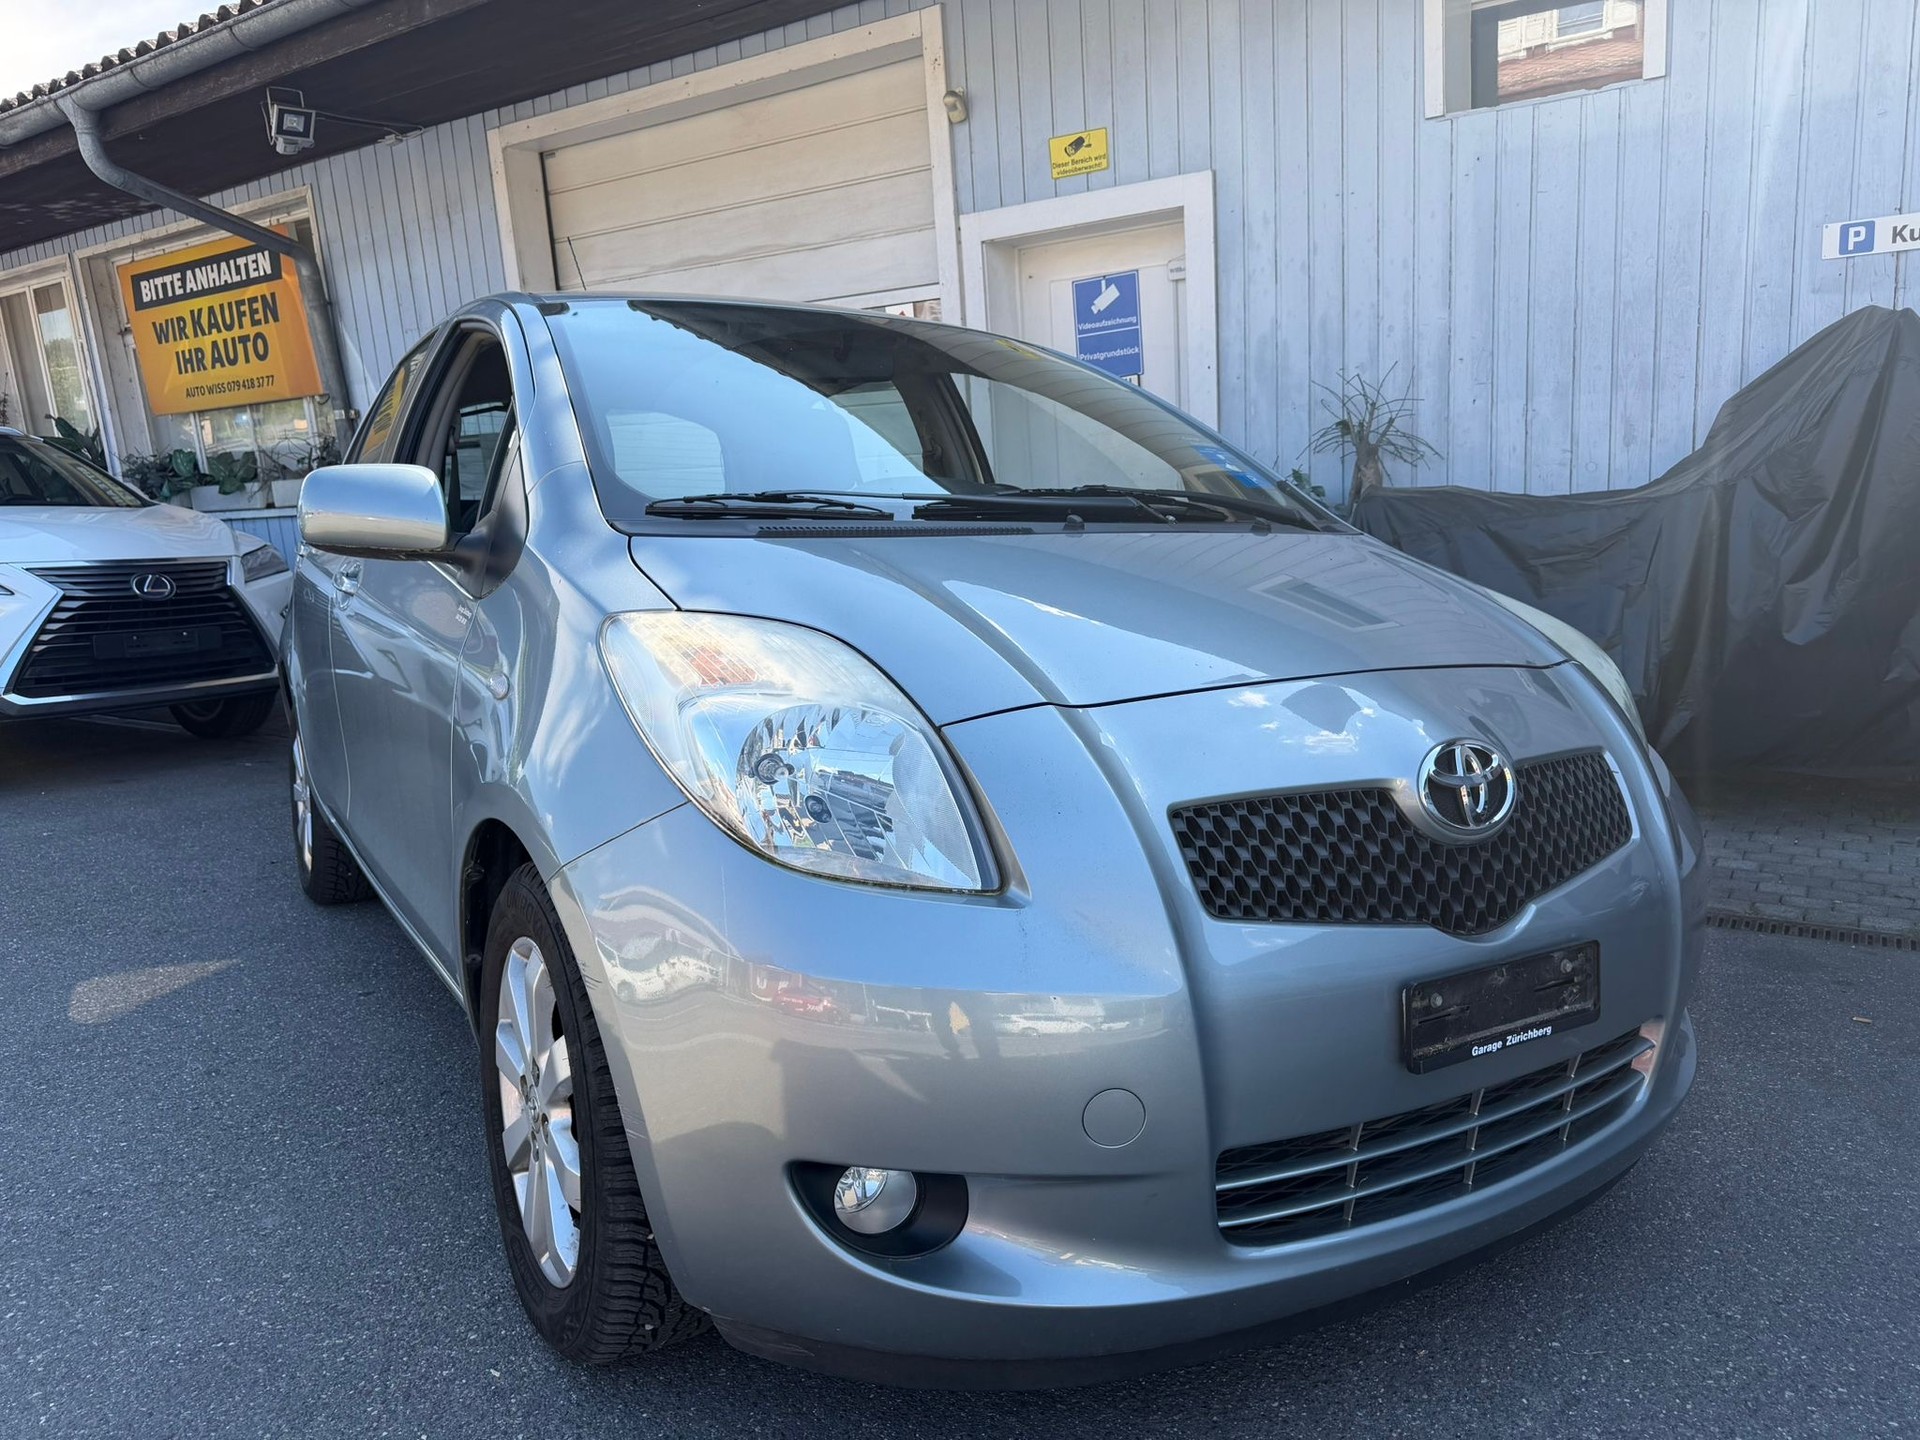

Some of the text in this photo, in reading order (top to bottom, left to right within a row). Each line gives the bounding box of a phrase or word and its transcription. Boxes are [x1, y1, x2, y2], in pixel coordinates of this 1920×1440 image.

[1053, 153, 1106, 169] Dieser Bereich wird
[1847, 226, 1866, 251] P
[140, 250, 272, 303] BITTE ANHALTEN
[152, 292, 280, 345] WIR KAUFEN
[1078, 316, 1137, 331] Videoaufzeichnung
[175, 332, 269, 375] IHR AUTO
[1080, 346, 1139, 361] Privatgrundstück
[185, 375, 275, 398] AUTO WISS 079 418 37 77
[1471, 1025, 1552, 1057] Garage Zürichberg
